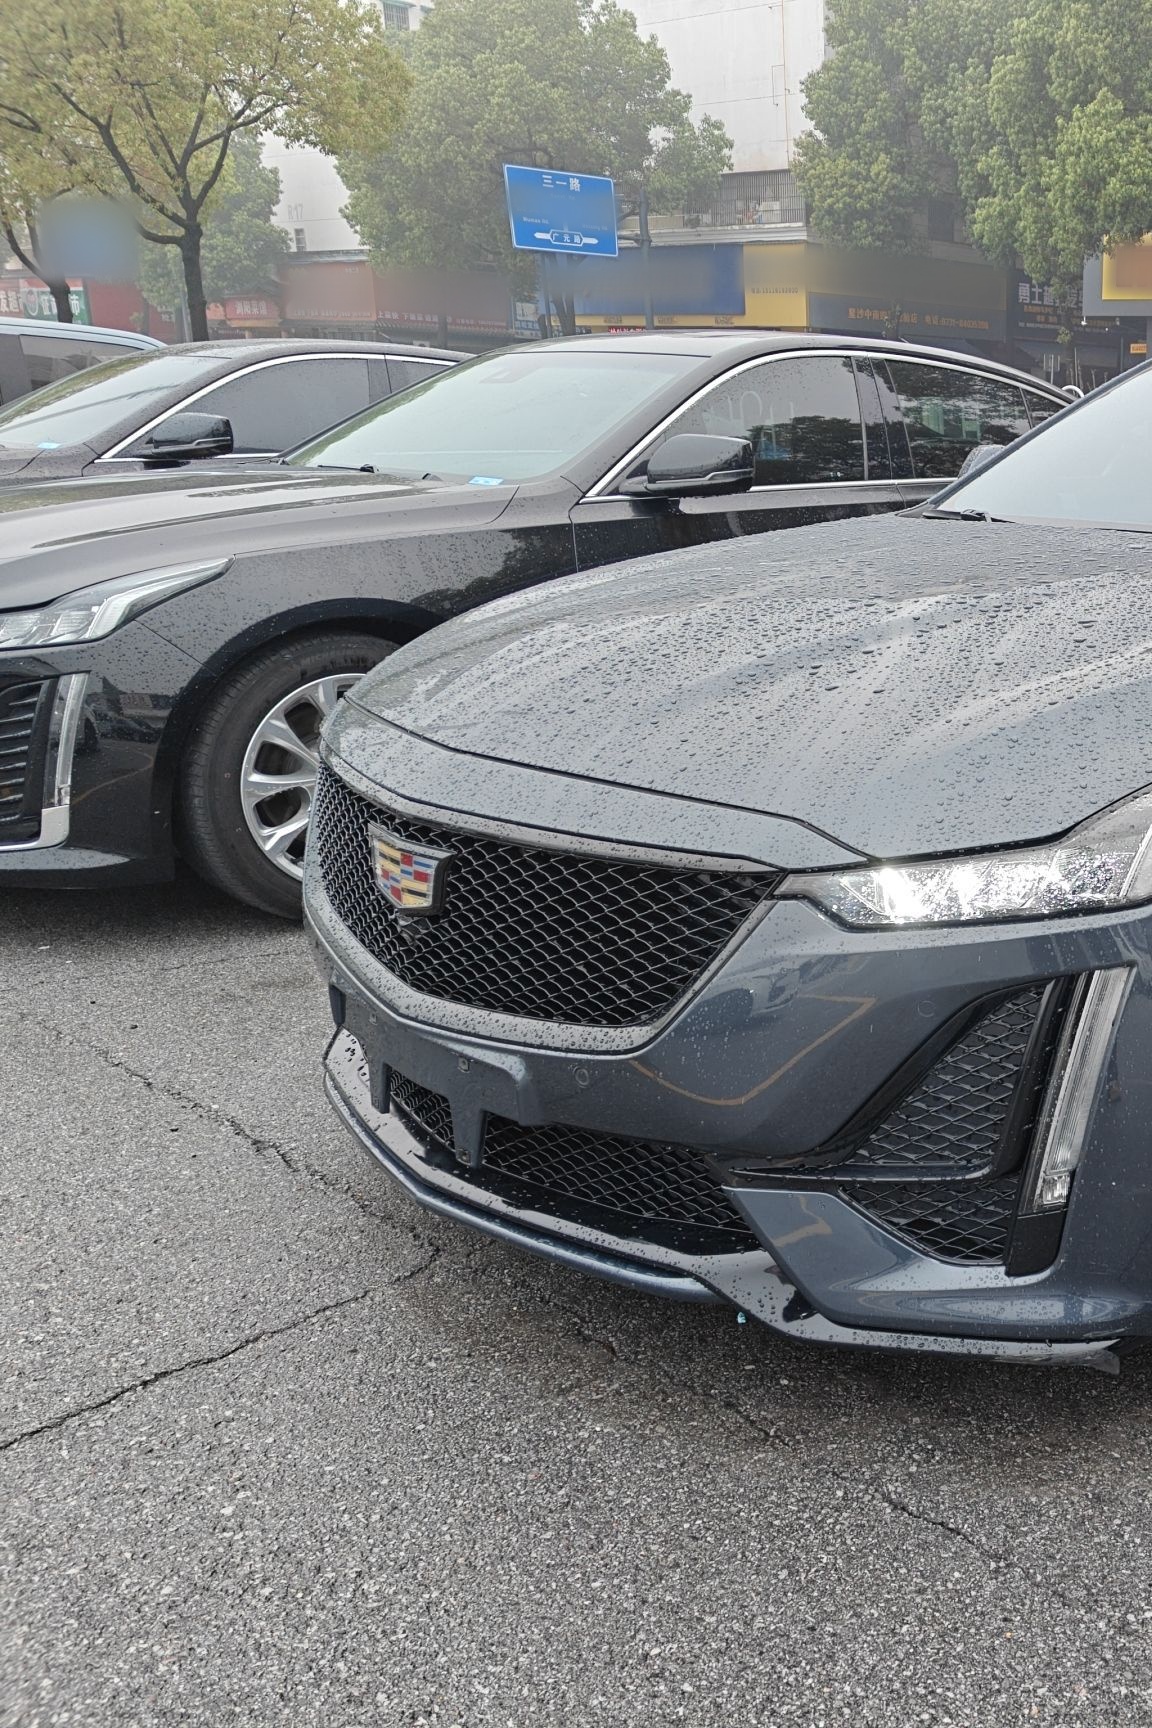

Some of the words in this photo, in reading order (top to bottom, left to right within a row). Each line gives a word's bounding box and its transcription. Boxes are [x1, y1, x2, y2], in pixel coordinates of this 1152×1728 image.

[542, 175, 581, 192] 三一路
[552, 233, 581, 244] 广元路
